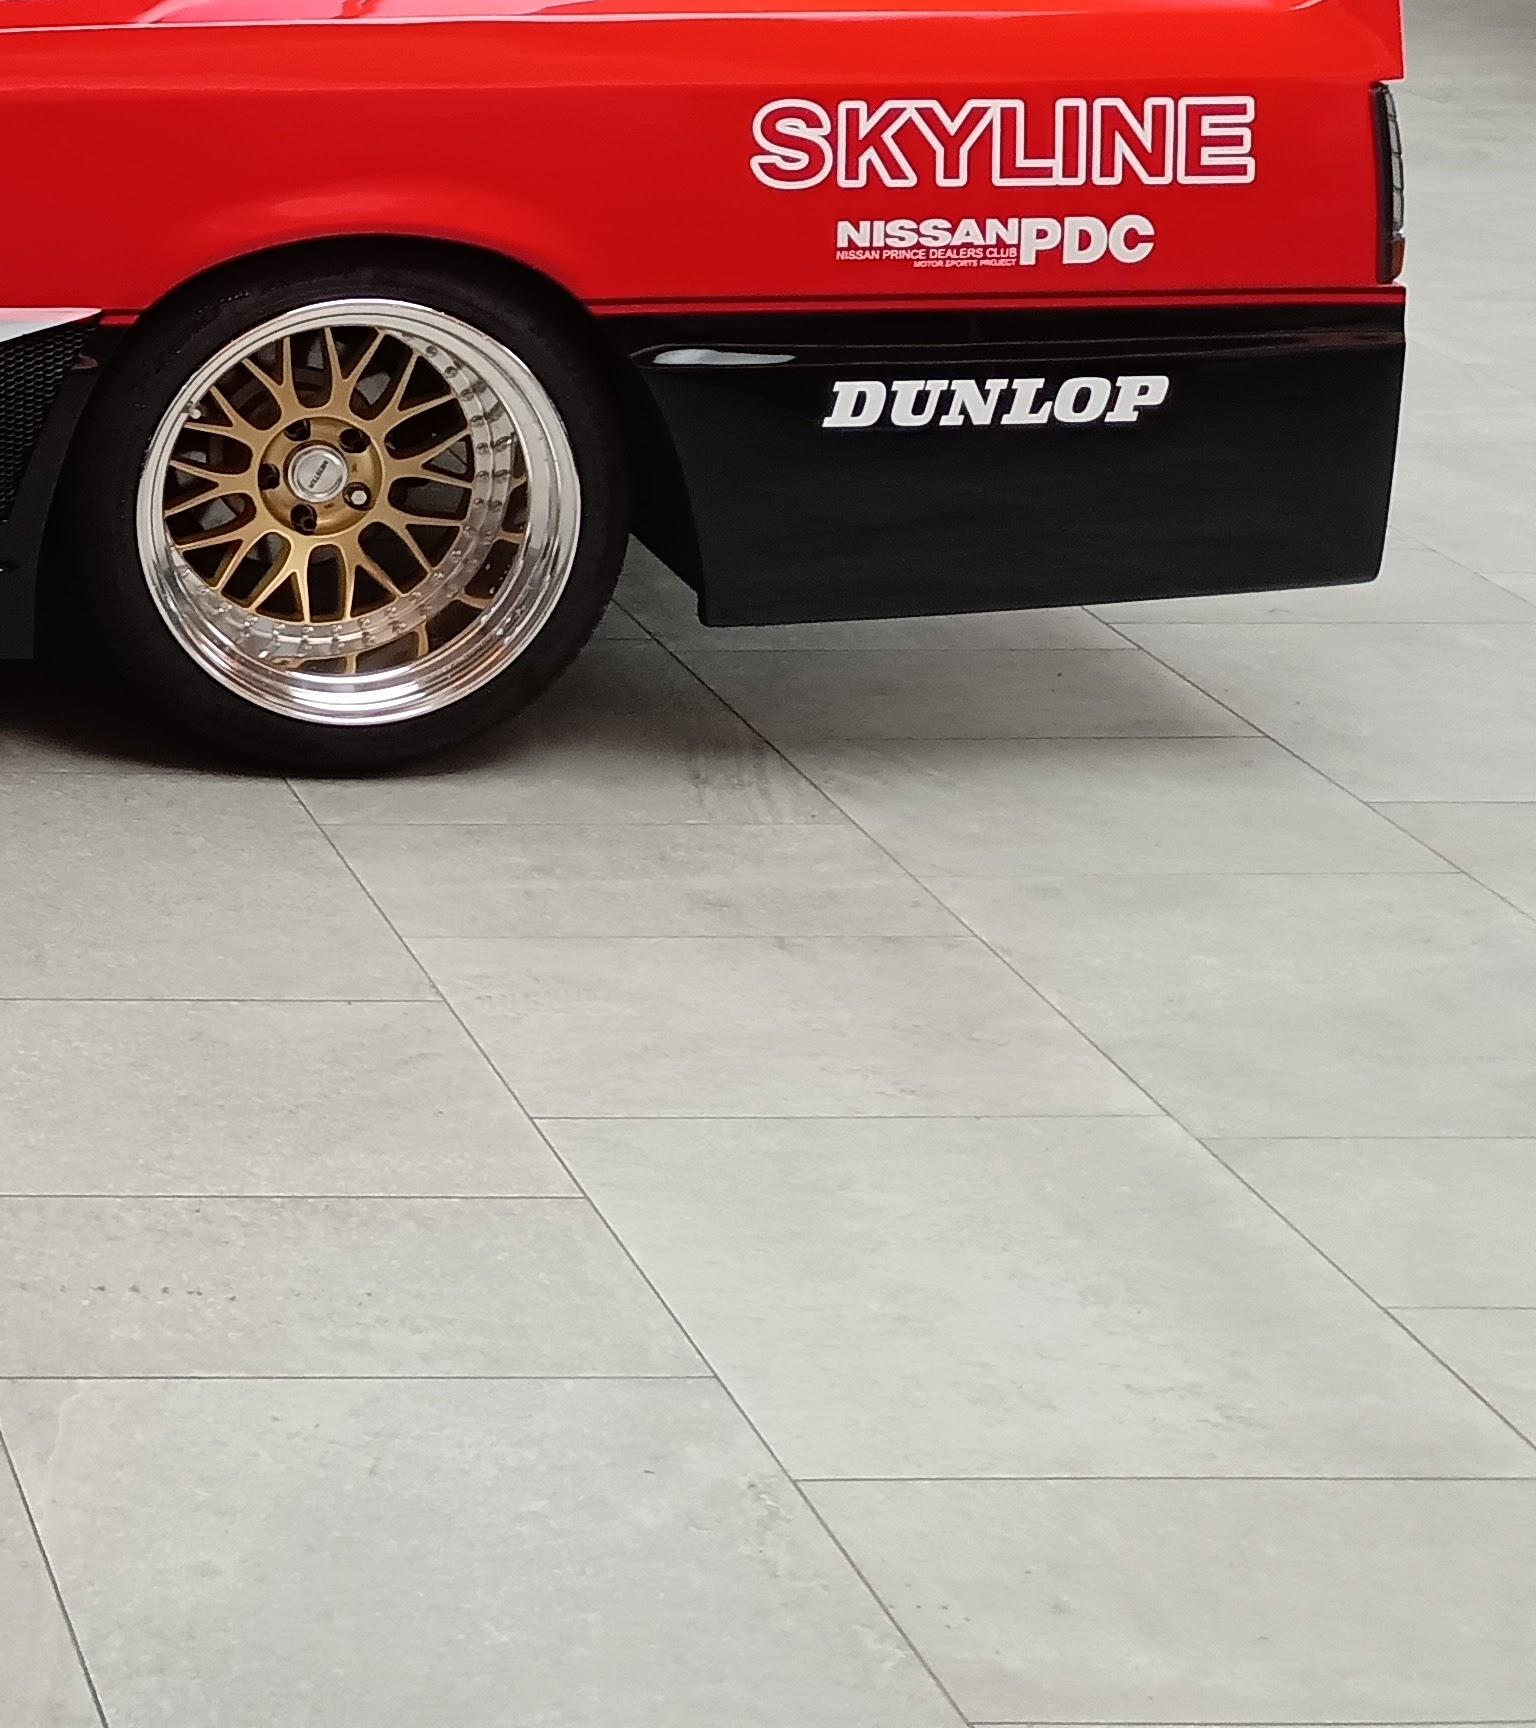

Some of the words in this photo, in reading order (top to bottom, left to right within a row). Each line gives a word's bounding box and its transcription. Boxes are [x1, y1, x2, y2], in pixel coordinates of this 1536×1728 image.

[749, 96, 1256, 188] SKYLINE
[836, 217, 1020, 248] NISSAN
[1019, 214, 1155, 266] PDC
[836, 250, 879, 261] NISSAN
[882, 249, 927, 260] PRINCE
[929, 248, 983, 259] DEALERS
[986, 247, 1018, 258] CLUB
[913, 260, 944, 268] MOTOR
[979, 258, 1017, 267] PROJECT
[822, 375, 1170, 428] DUNLOP
